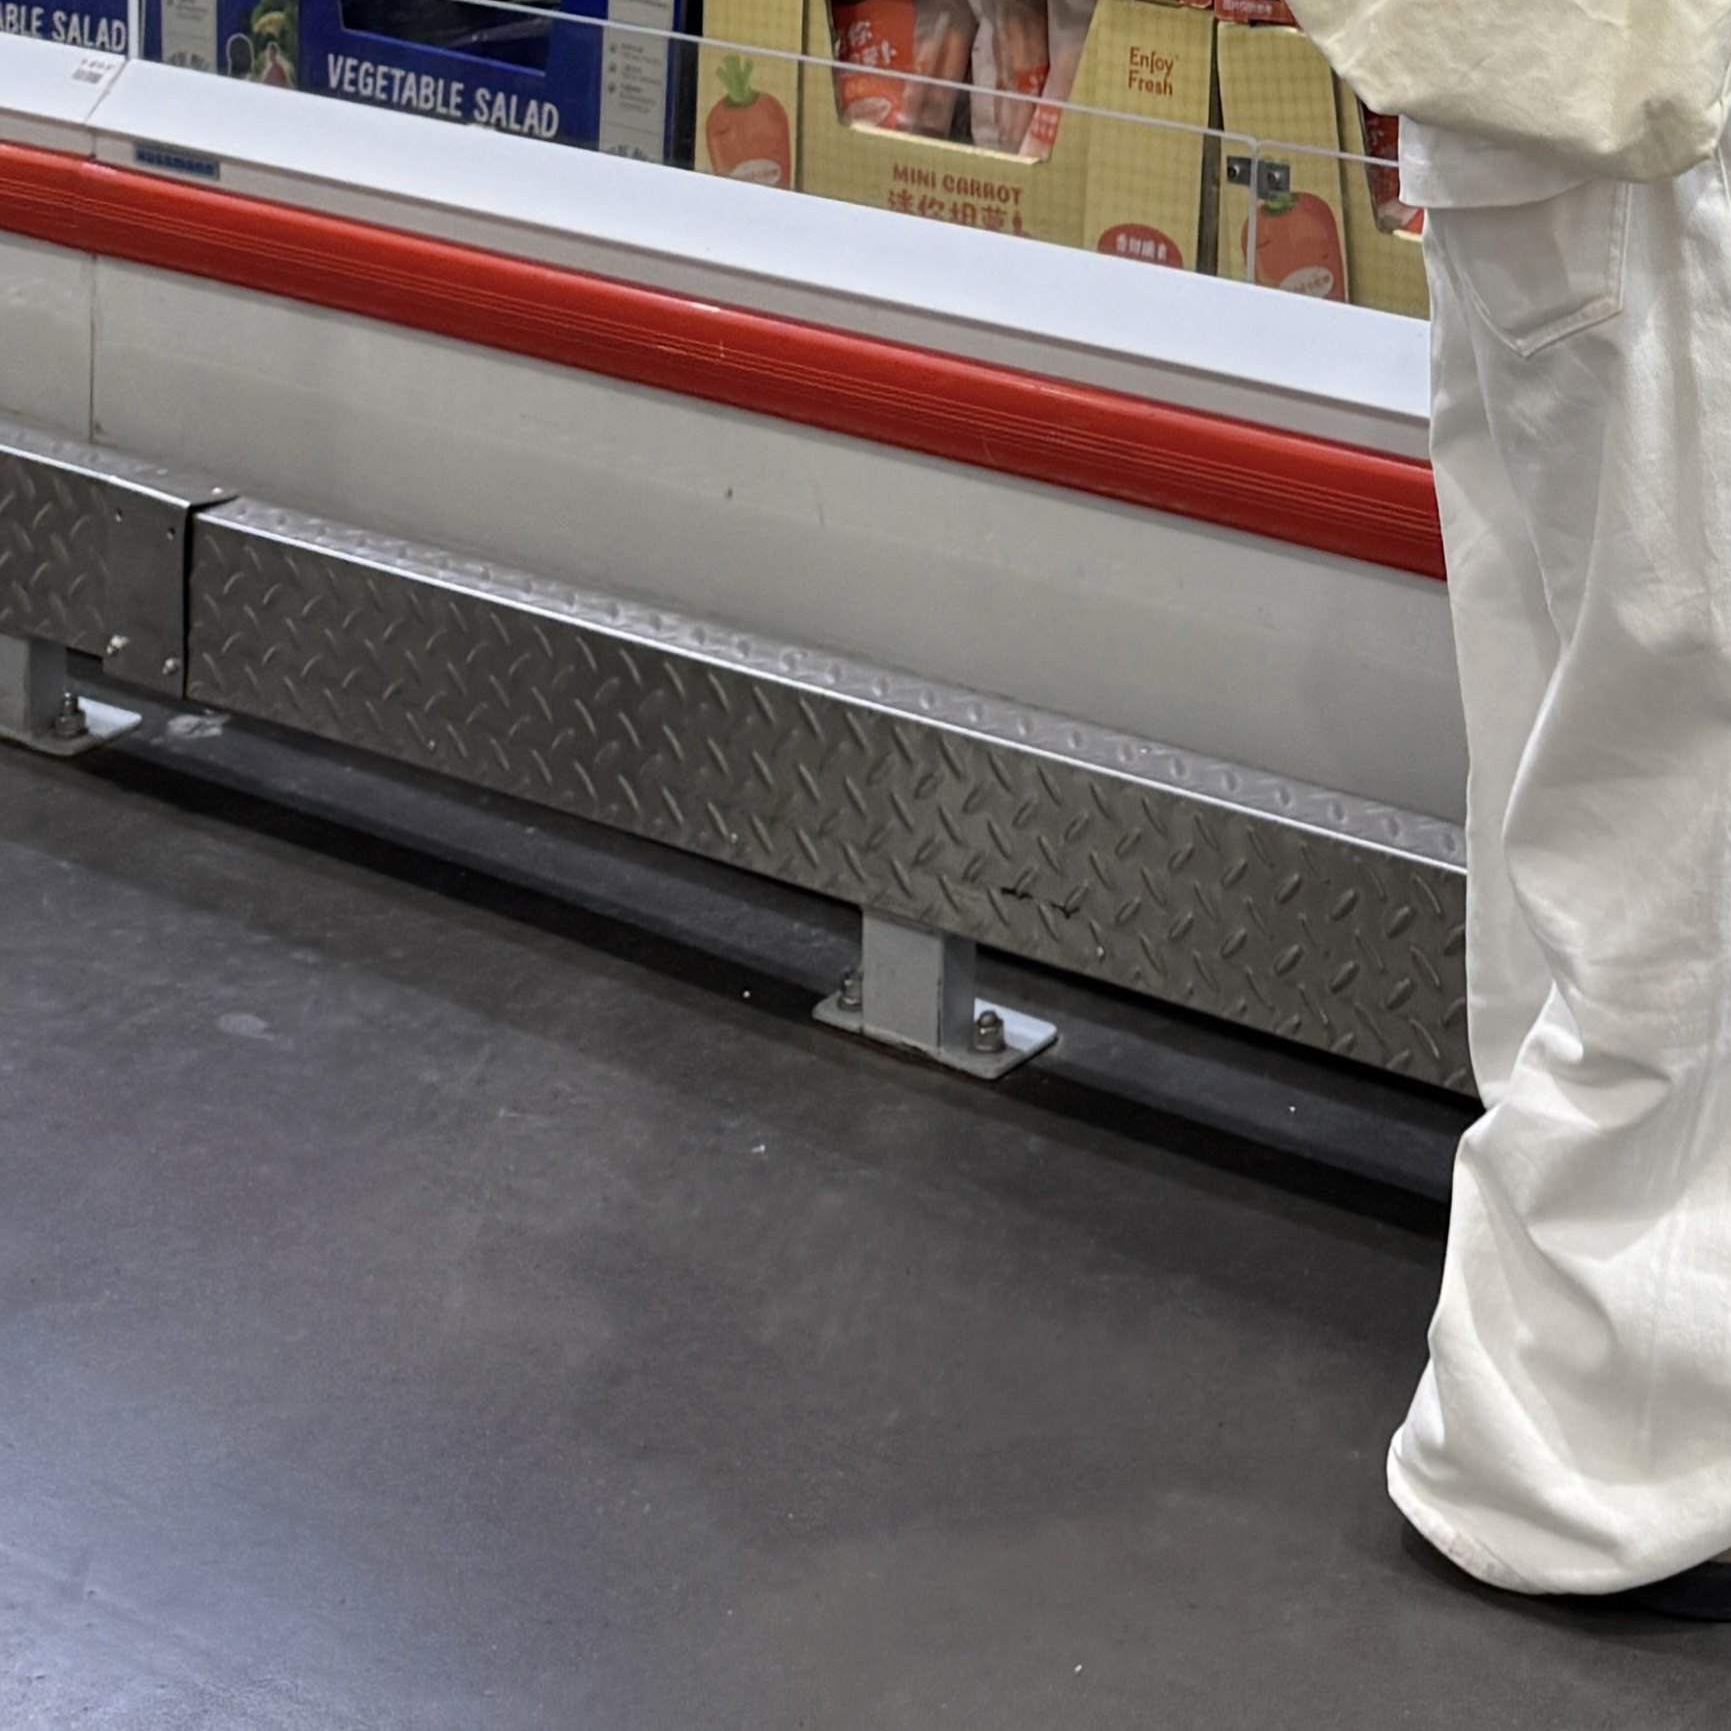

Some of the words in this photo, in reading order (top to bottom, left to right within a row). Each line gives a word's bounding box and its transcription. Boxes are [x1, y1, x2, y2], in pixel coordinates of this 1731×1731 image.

[0, 2, 44, 37] BLE
[51, 10, 126, 51] SALAD
[1129, 47, 1174, 75] Enjoy
[327, 53, 463, 118] VEGETABLE
[473, 85, 559, 139] SALAD
[1128, 70, 1173, 97] Fresh
[893, 163, 936, 189] MINI
[942, 174, 1023, 206] CARROT
